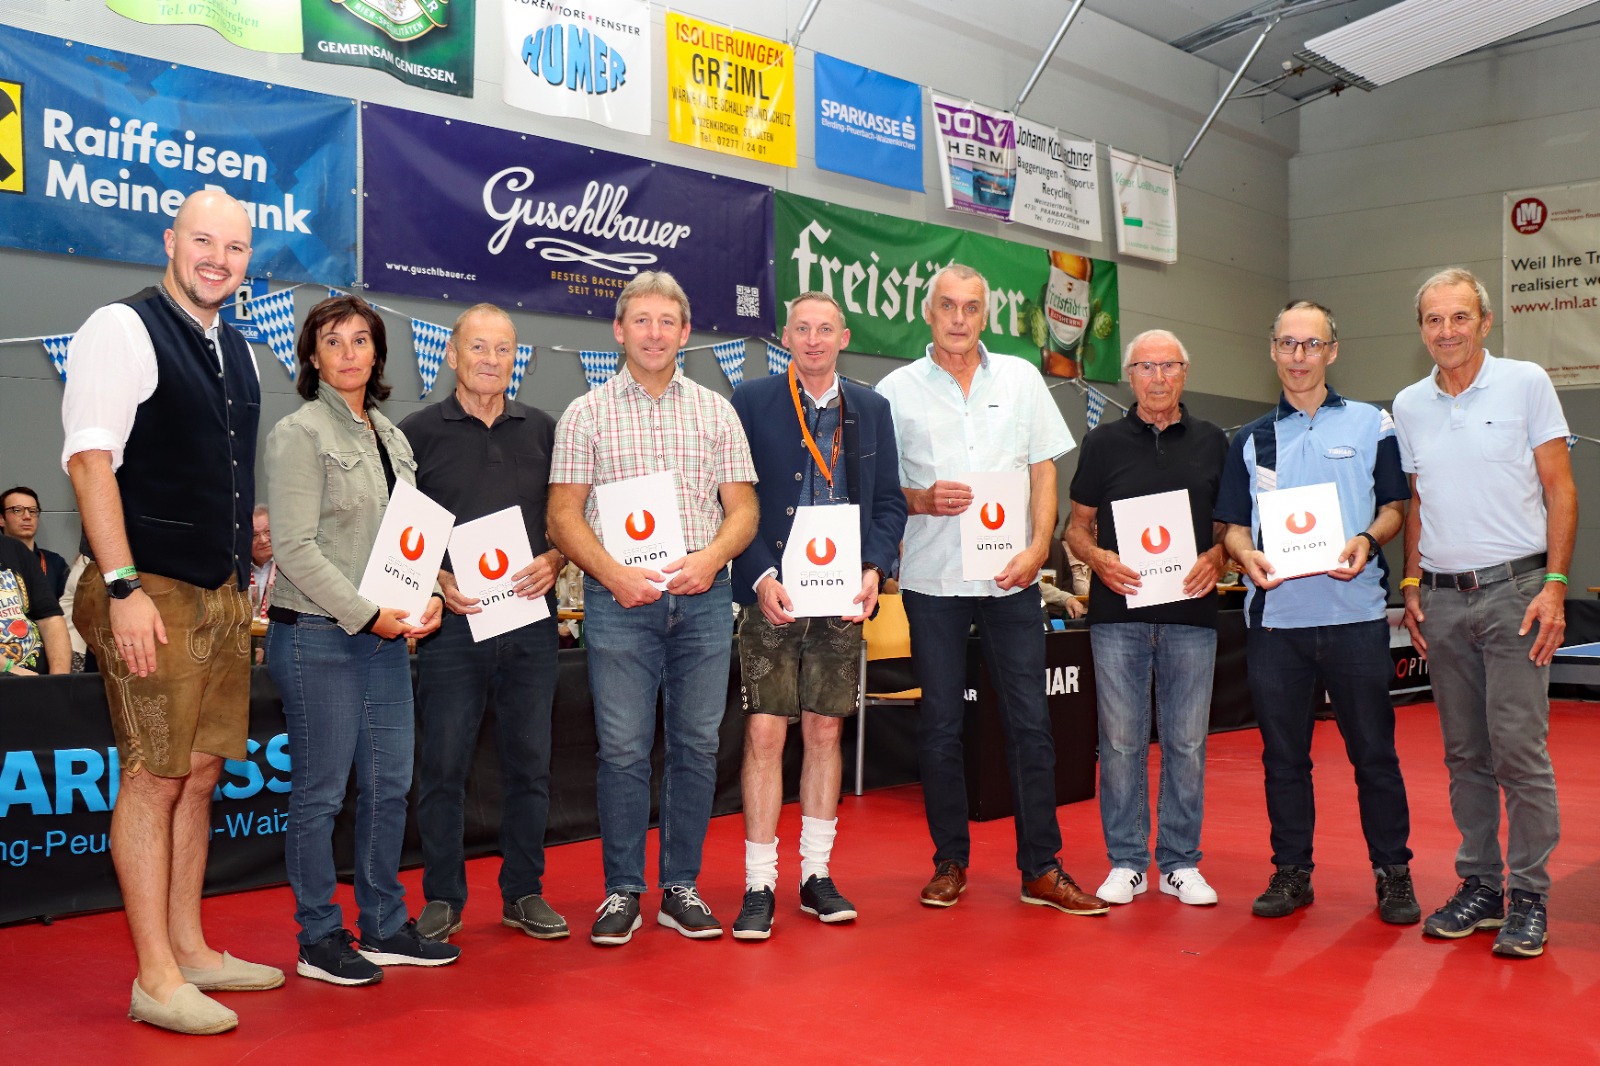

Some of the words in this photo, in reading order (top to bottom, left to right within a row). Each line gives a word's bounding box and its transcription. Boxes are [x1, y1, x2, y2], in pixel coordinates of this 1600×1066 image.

[559, 6, 586, 20] TORE
[595, 16, 640, 36] FENSTER
[676, 22, 784, 68] ISOLIERUNGEN
[317, 40, 394, 64] GEMEINSAM
[395, 56, 457, 84] GENIESSEN.
[521, 23, 627, 95] HUMER
[691, 53, 770, 100] GREIML
[820, 98, 901, 137] SPARKASSE
[43, 107, 267, 184] Raiffeisen
[716, 135, 739, 149] 07277
[1017, 126, 1047, 154] Johann
[1017, 156, 1059, 182] Baggerungen
[45, 159, 183, 218] Meine
[1042, 182, 1073, 205] Recycling
[482, 166, 690, 255] Guschlbauer
[386, 262, 477, 281] www.guschlbauer.cc
[1511, 256, 1546, 271] Weil
[1552, 254, 1582, 268] Ihre
[550, 270, 588, 284] BESTES
[1510, 276, 1579, 293] realisiert
[568, 285, 589, 296] SEIT
[594, 288, 617, 299] 1919.
[1510, 295, 1598, 313] www.lml.at
[976, 542, 1013, 551] union
[1282, 541, 1327, 553] union
[624, 550, 668, 565] union
[383, 563, 420, 591] union
[1140, 564, 1182, 577] union
[800, 578, 845, 587] union
[481, 589, 515, 606] unio
